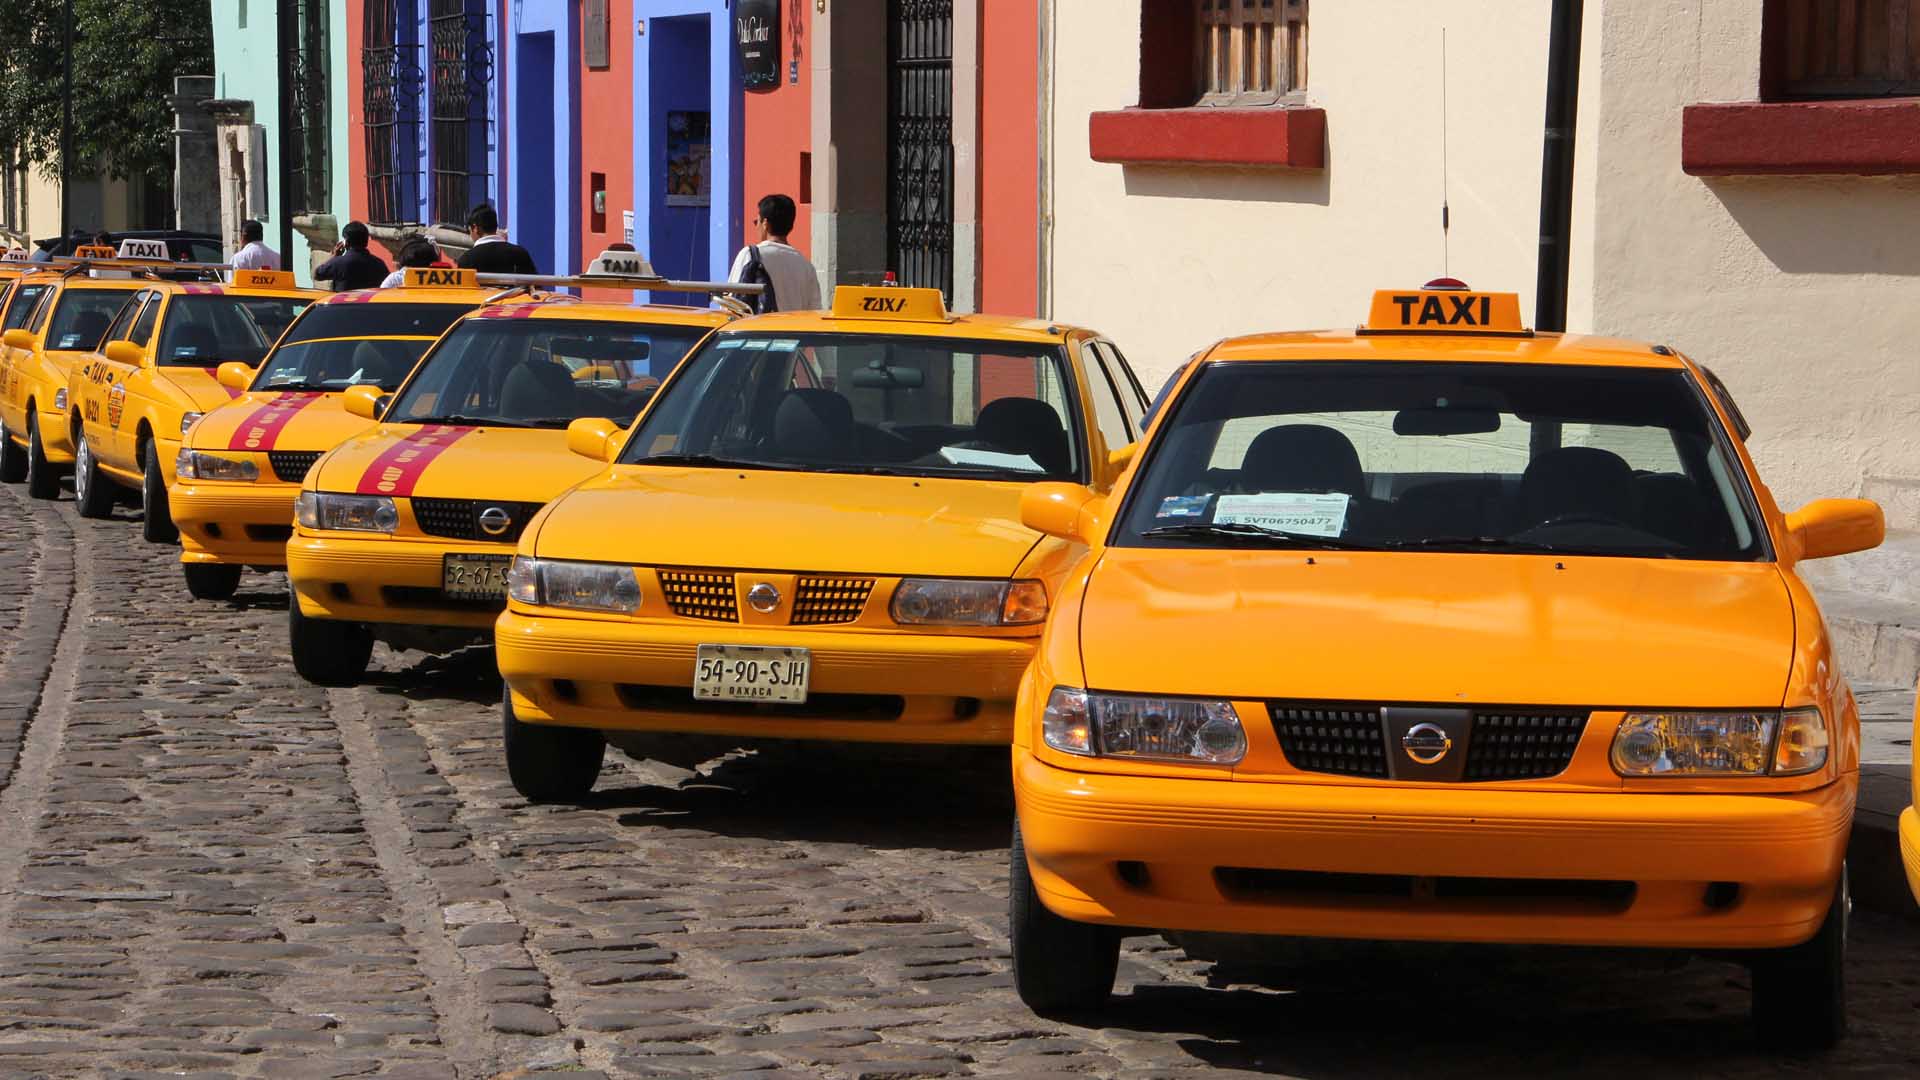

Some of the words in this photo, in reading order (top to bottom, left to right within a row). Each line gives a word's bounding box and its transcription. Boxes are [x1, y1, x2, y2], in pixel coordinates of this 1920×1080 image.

[127, 243, 162, 257] TAXI
[602, 258, 640, 273] TAXI
[415, 269, 462, 286] TAXI
[863, 297, 906, 312] TAXI
[1393, 295, 1490, 326] TAXI
[700, 659, 805, 686] 54-90-SJH
[729, 686, 772, 697] OAXACA
